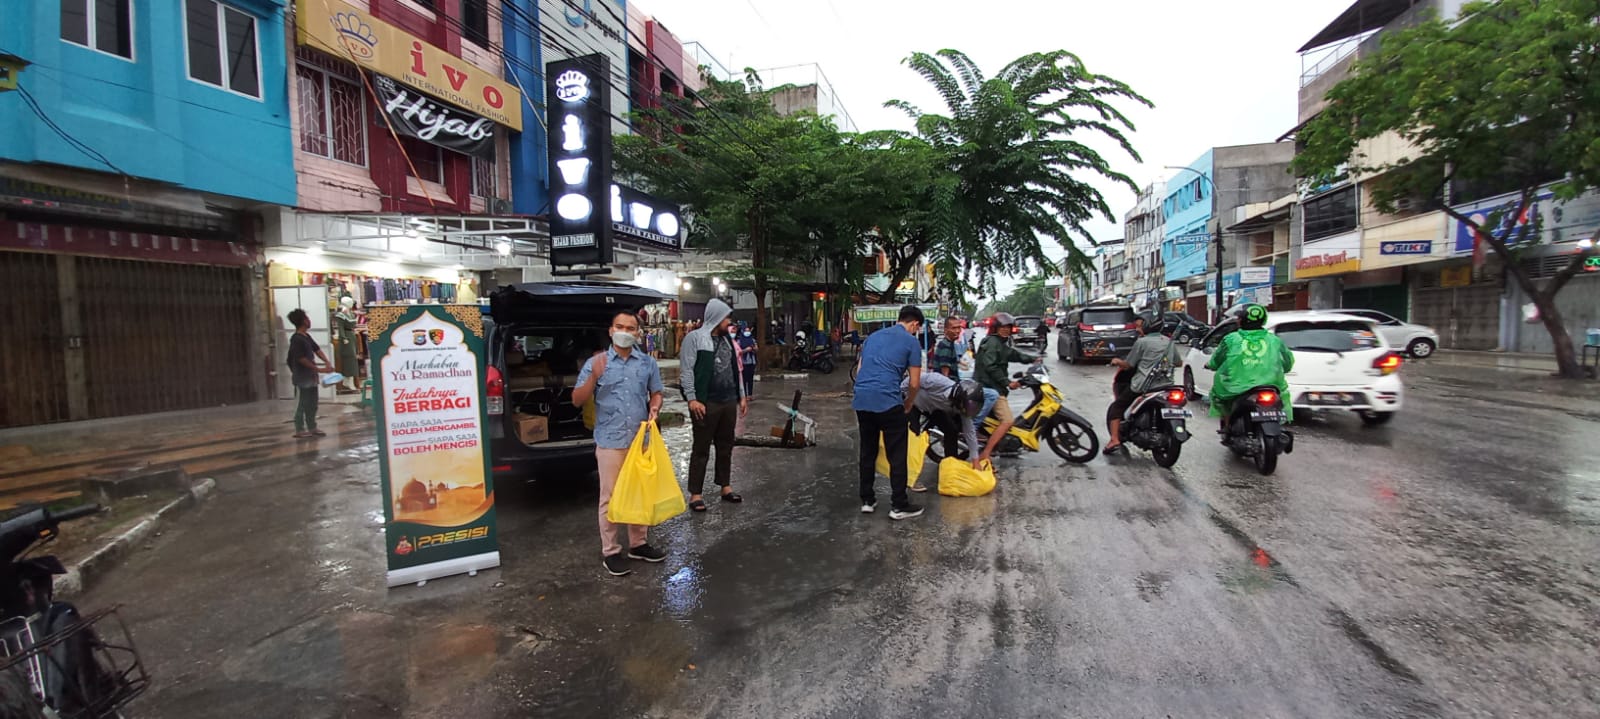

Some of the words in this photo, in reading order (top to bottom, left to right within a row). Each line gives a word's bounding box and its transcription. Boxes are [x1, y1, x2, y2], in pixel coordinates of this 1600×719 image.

[410, 41, 504, 109] ivo
[402, 72, 474, 110] INTERNATIONAL
[476, 104, 511, 124] FASHION
[385, 90, 494, 141] Hijab
[552, 236, 569, 247] HIJAB
[570, 234, 593, 246] FASHION
[400, 354, 460, 371] Marhaban
[391, 371, 406, 381] Ya
[411, 368, 472, 380] Ramadhan
[393, 386, 458, 401] Indahnya
[393, 397, 471, 414] BERBAGI
[391, 421, 419, 430] SIAPA
[421, 418, 442, 427] SAJA
[391, 427, 423, 437] BOLEH
[424, 422, 477, 433] MENGAMBIL
[428, 434, 454, 443] SIAPA
[456, 433, 478, 441] SAJA
[393, 444, 431, 456] BOLEH
[433, 440, 478, 452] MENGISI
[418, 526, 489, 548] PRESISI
